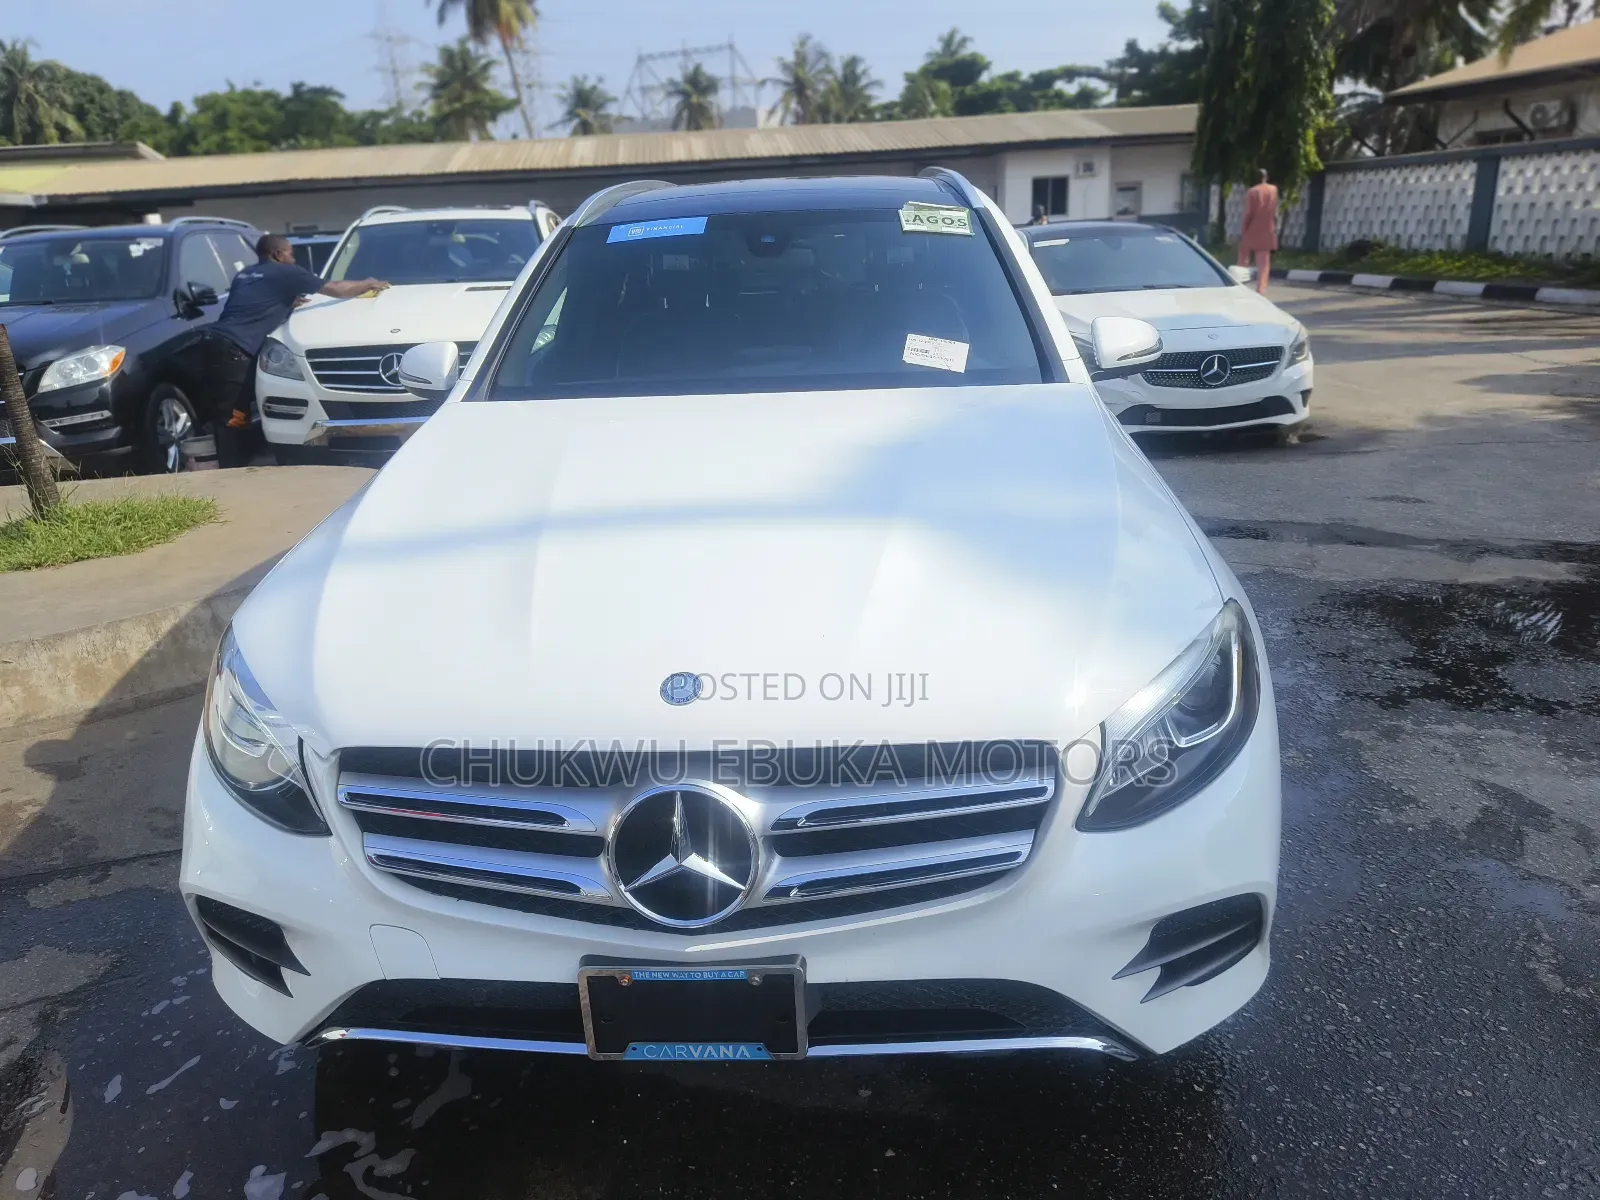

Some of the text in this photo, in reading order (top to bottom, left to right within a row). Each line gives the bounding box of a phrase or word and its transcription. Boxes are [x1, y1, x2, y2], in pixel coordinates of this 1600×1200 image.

[646, 224, 684, 232] FINANCIAL
[634, 971, 650, 979] THE
[651, 971, 670, 979] NEW
[671, 971, 689, 979] WAY
[689, 971, 701, 979] TO
[703, 970, 719, 979] BUY
[727, 970, 745, 979] CAR
[643, 1044, 751, 1059] CARVANA
